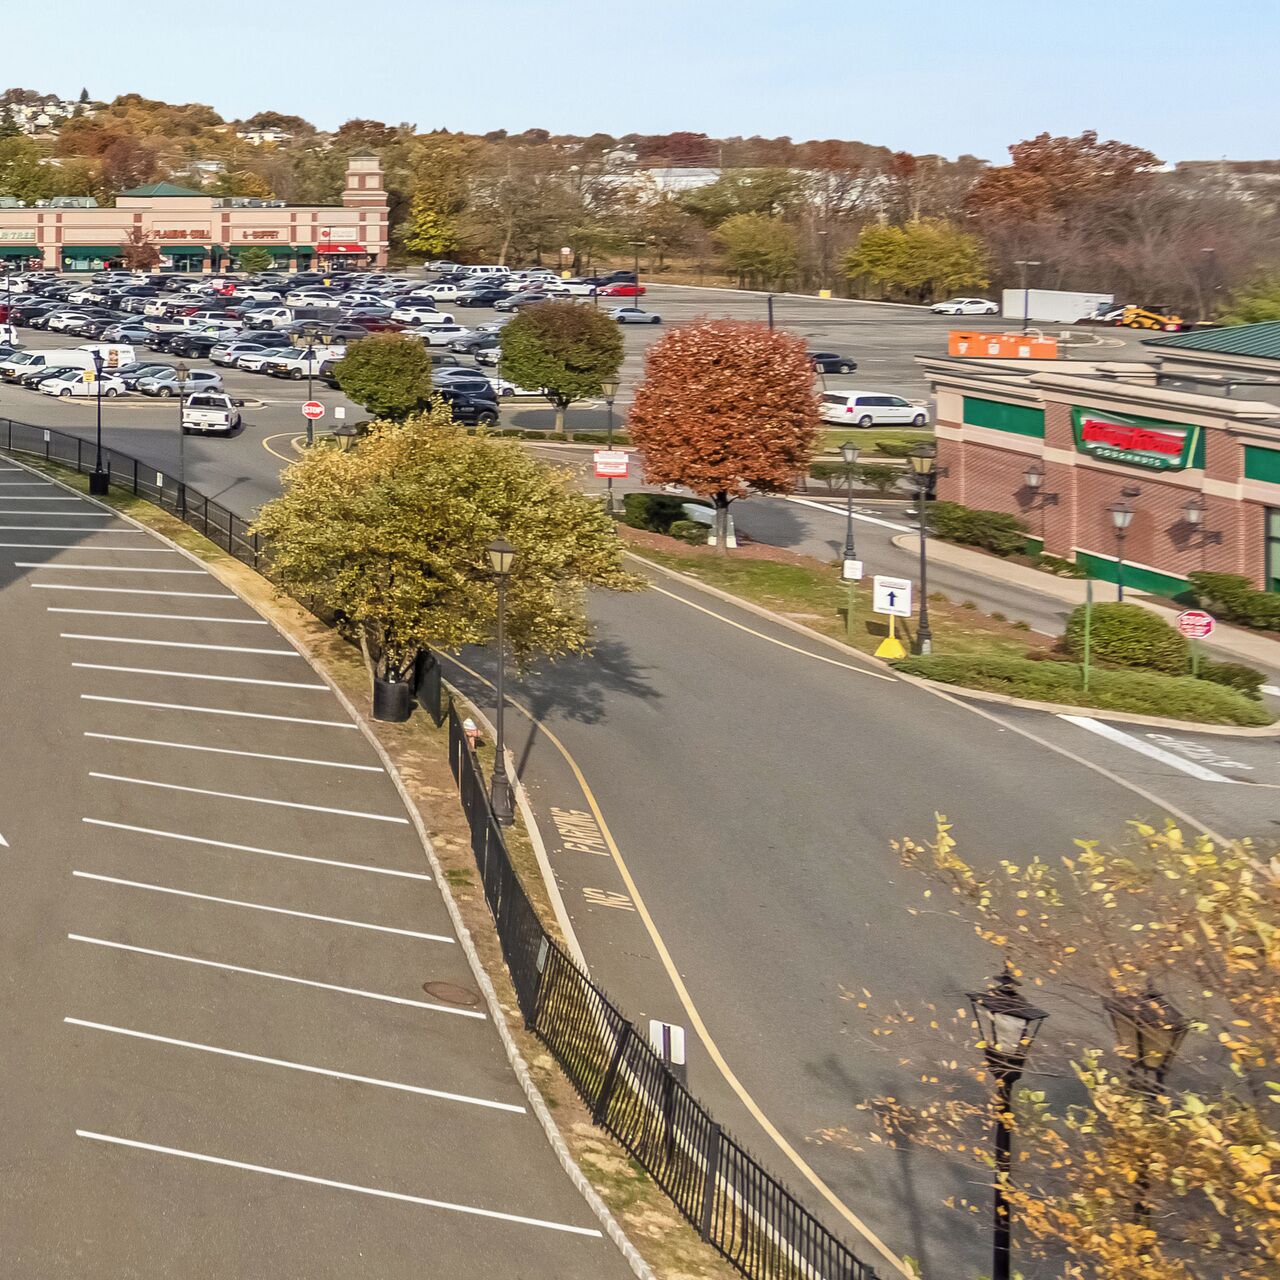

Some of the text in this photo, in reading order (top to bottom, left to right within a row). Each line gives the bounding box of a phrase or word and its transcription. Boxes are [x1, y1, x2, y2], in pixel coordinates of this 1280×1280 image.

[10, 231, 36, 239] TREE
[304, 405, 324, 414] STOP
[550, 807, 610, 856] PARKING
